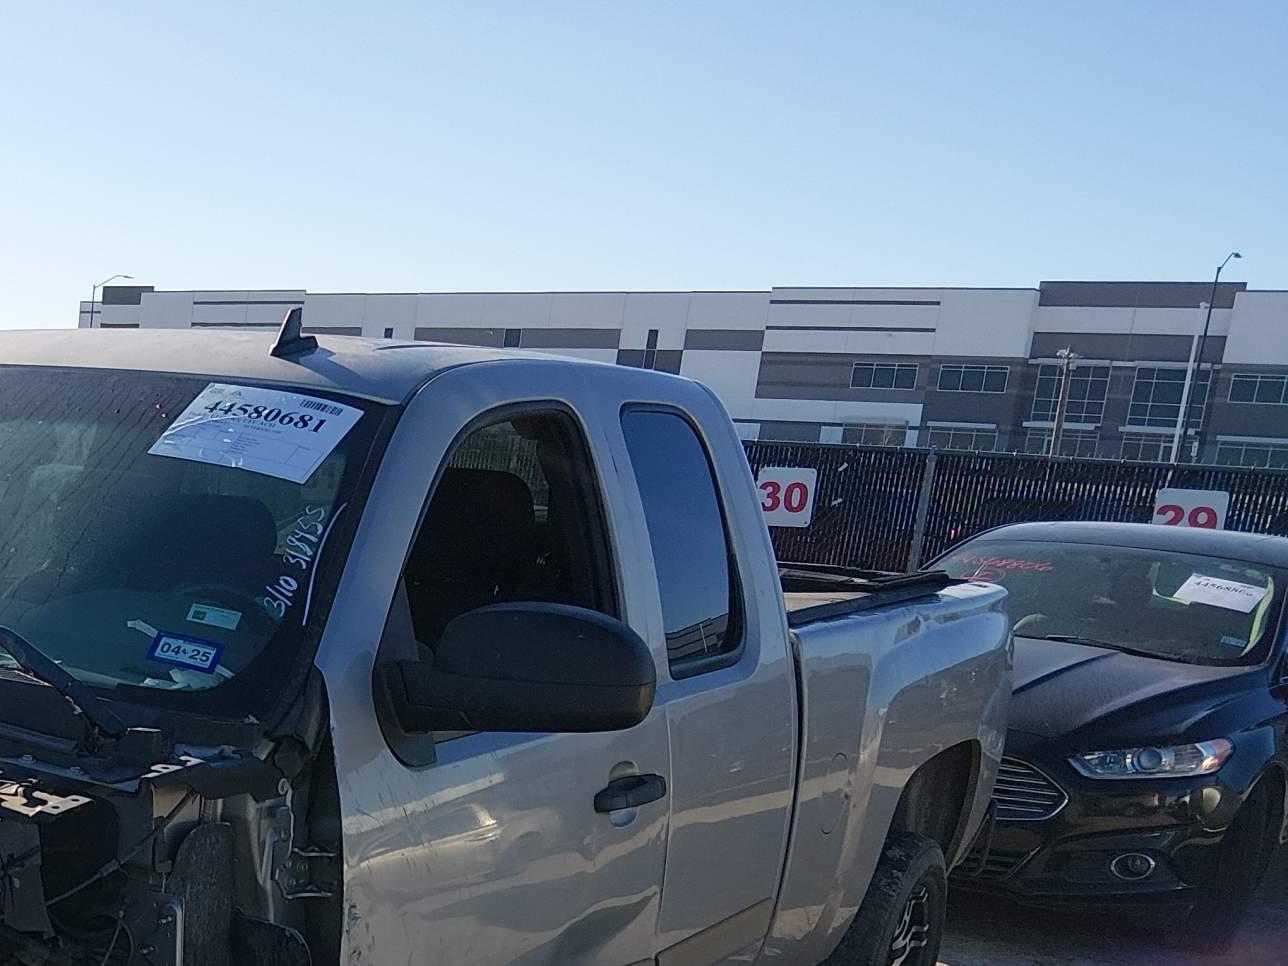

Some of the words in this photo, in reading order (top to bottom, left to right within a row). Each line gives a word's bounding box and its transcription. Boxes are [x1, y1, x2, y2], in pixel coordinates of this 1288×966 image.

[204, 400, 327, 433] 44580681
[759, 481, 809, 513] 30
[1156, 504, 1218, 530] 29
[160, 642, 181, 656] 04
[188, 648, 212, 663] 25
